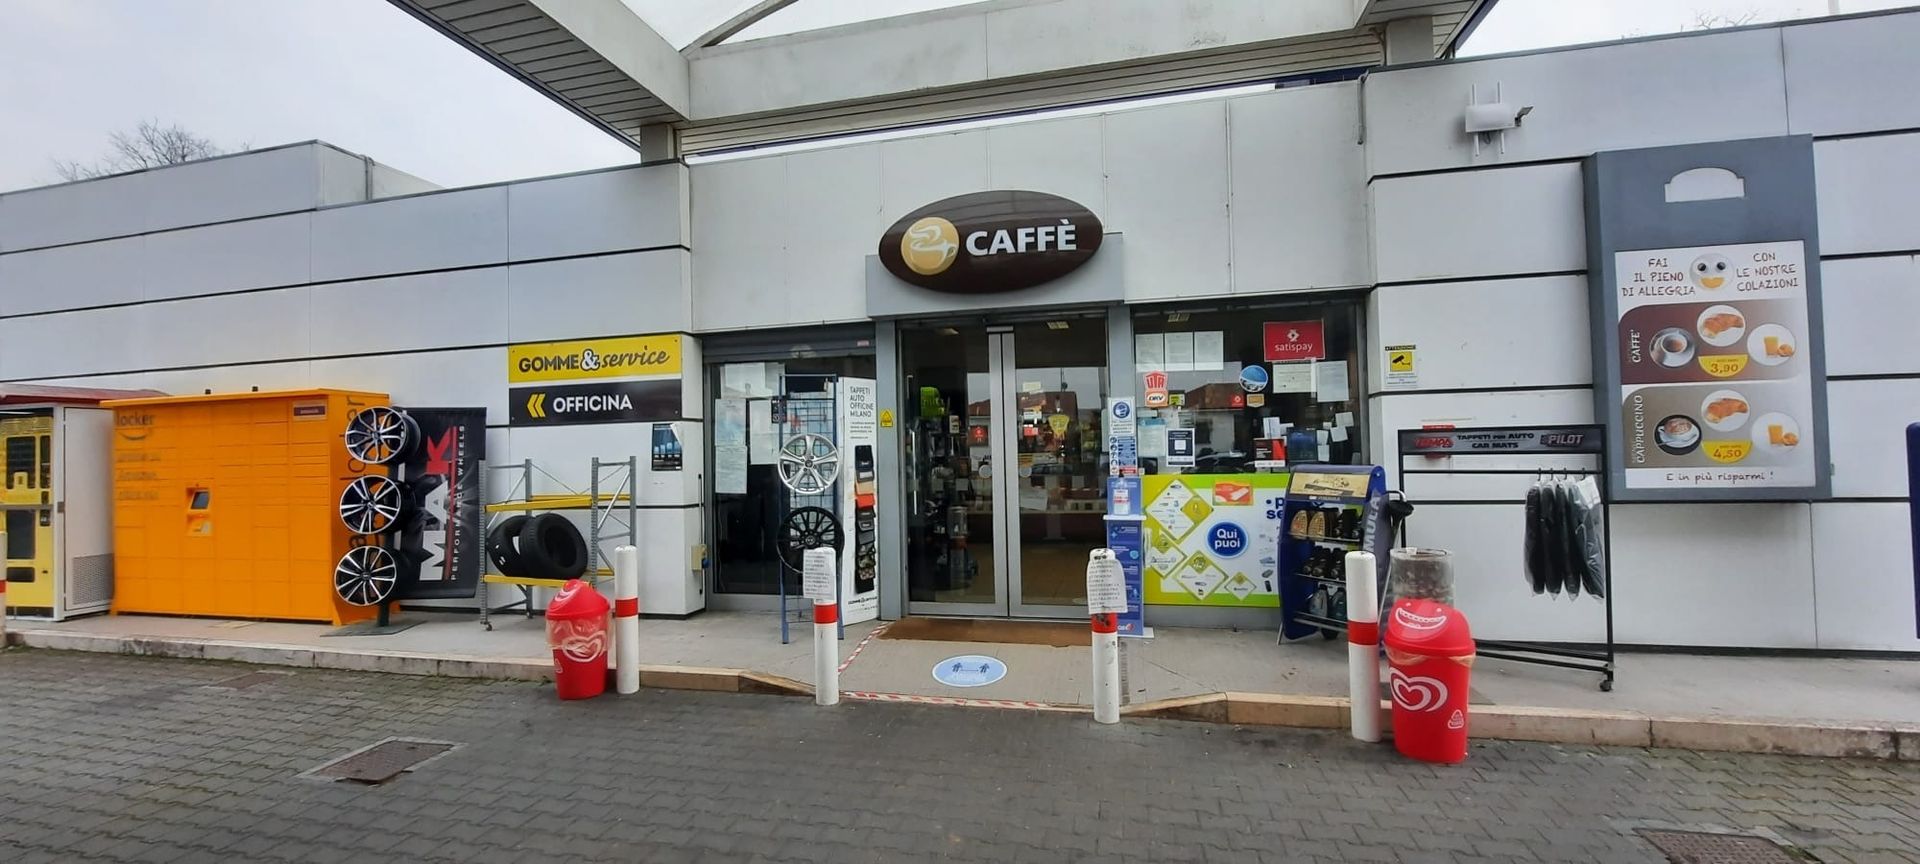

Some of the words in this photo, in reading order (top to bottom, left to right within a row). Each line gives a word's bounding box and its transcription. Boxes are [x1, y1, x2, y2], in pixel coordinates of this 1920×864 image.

[965, 218, 1077, 256] CAFFÈ
[1648, 258, 1669, 268] FAI
[1753, 252, 1776, 263] CON
[1633, 272, 1646, 282] IL
[1650, 272, 1684, 282] PIENO
[1736, 267, 1750, 278] LE
[1754, 264, 1797, 276] NOSTRE
[1736, 277, 1799, 292] COLAZIONI
[1621, 287, 1634, 297] DI
[1638, 285, 1696, 296] ALLEGRIA
[1274, 341, 1313, 353] satispay
[849, 386, 871, 395] TAPPETI
[552, 394, 633, 413] OFFICINA
[849, 394, 865, 402] AUTO
[849, 402, 874, 411] OFFICINE
[849, 410, 872, 418] MILANO
[1633, 395, 1646, 464] CAPPUCCINO
[1508, 432, 1535, 440] AUTO
[1548, 434, 1584, 444] PILOT
[457, 425, 466, 476] WHEELS
[1713, 448, 1742, 459] 4,50
[1666, 473, 1674, 481] E
[1678, 472, 1689, 481] in
[1695, 472, 1713, 485] più
[1717, 472, 1766, 485] risparmi
[419, 425, 452, 581] MAK
[451, 483, 464, 581] PERFORMANCE
[1216, 528, 1238, 540] Qui
[1214, 539, 1241, 550] puoi
